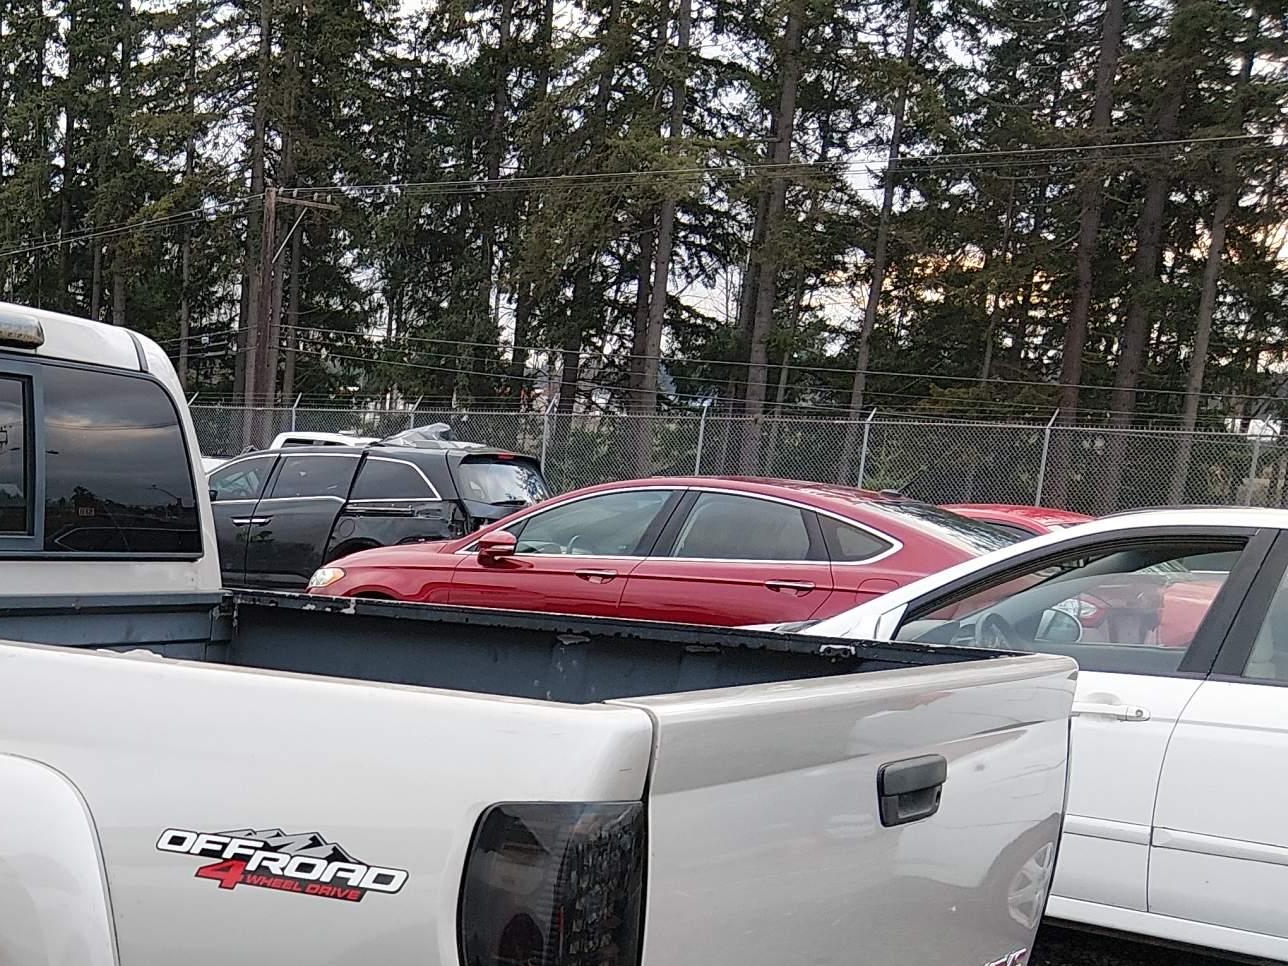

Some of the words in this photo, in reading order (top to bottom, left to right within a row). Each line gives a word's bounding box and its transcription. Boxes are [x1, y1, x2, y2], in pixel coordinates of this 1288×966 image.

[196, 858, 246, 889] 4
[245, 873, 302, 892] WHEEL
[305, 882, 361, 900] DRIVE
